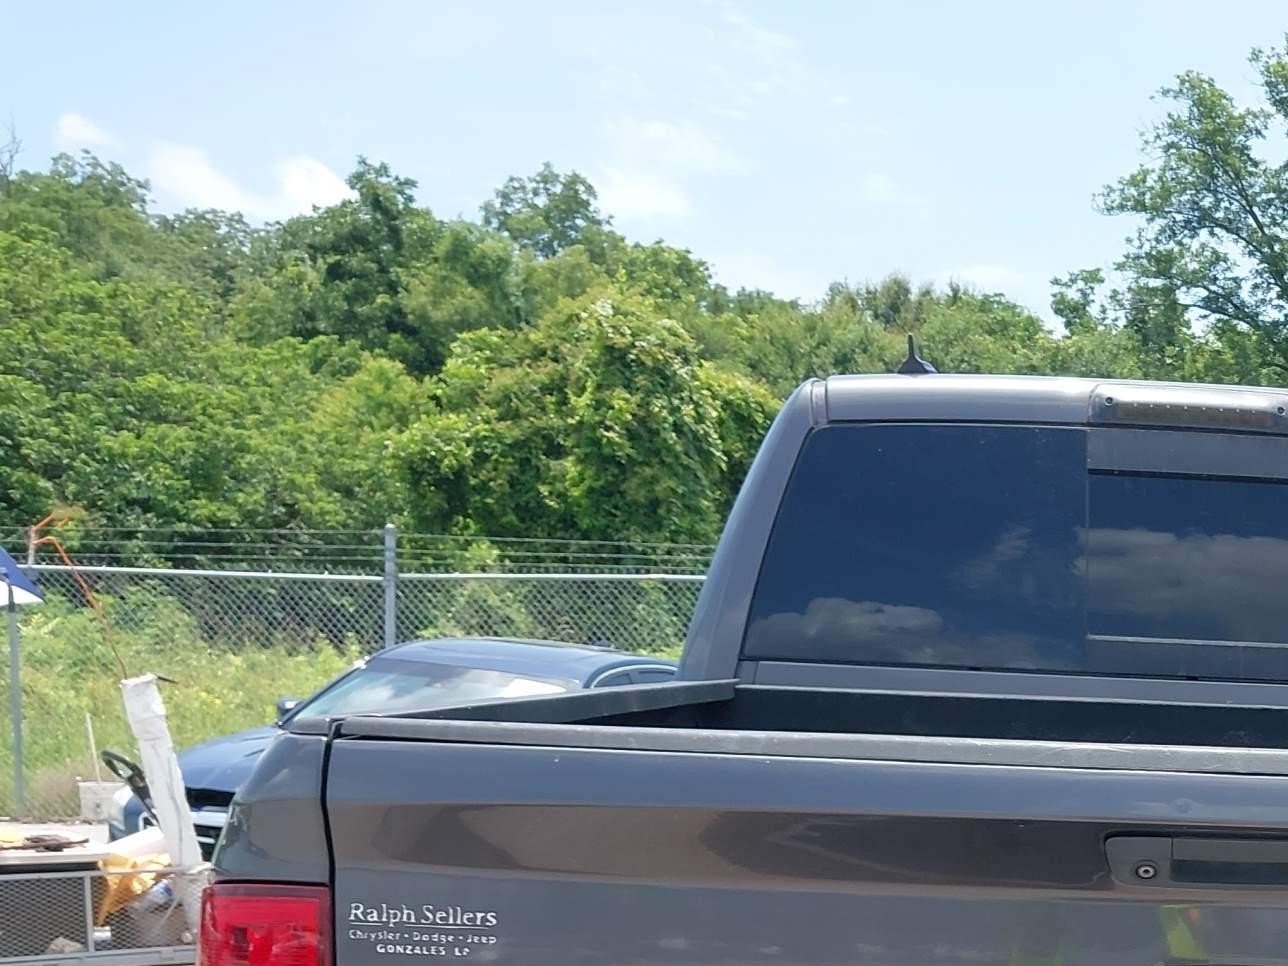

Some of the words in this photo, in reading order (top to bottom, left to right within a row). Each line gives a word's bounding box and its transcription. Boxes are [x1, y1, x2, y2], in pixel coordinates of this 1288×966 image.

[349, 903, 416, 927] Ralph
[420, 905, 498, 927] Sellers
[349, 929, 401, 942] Chrysler
[412, 931, 455, 944] Dodge
[466, 934, 497, 945] Jeep
[376, 943, 446, 956] GONZALES
